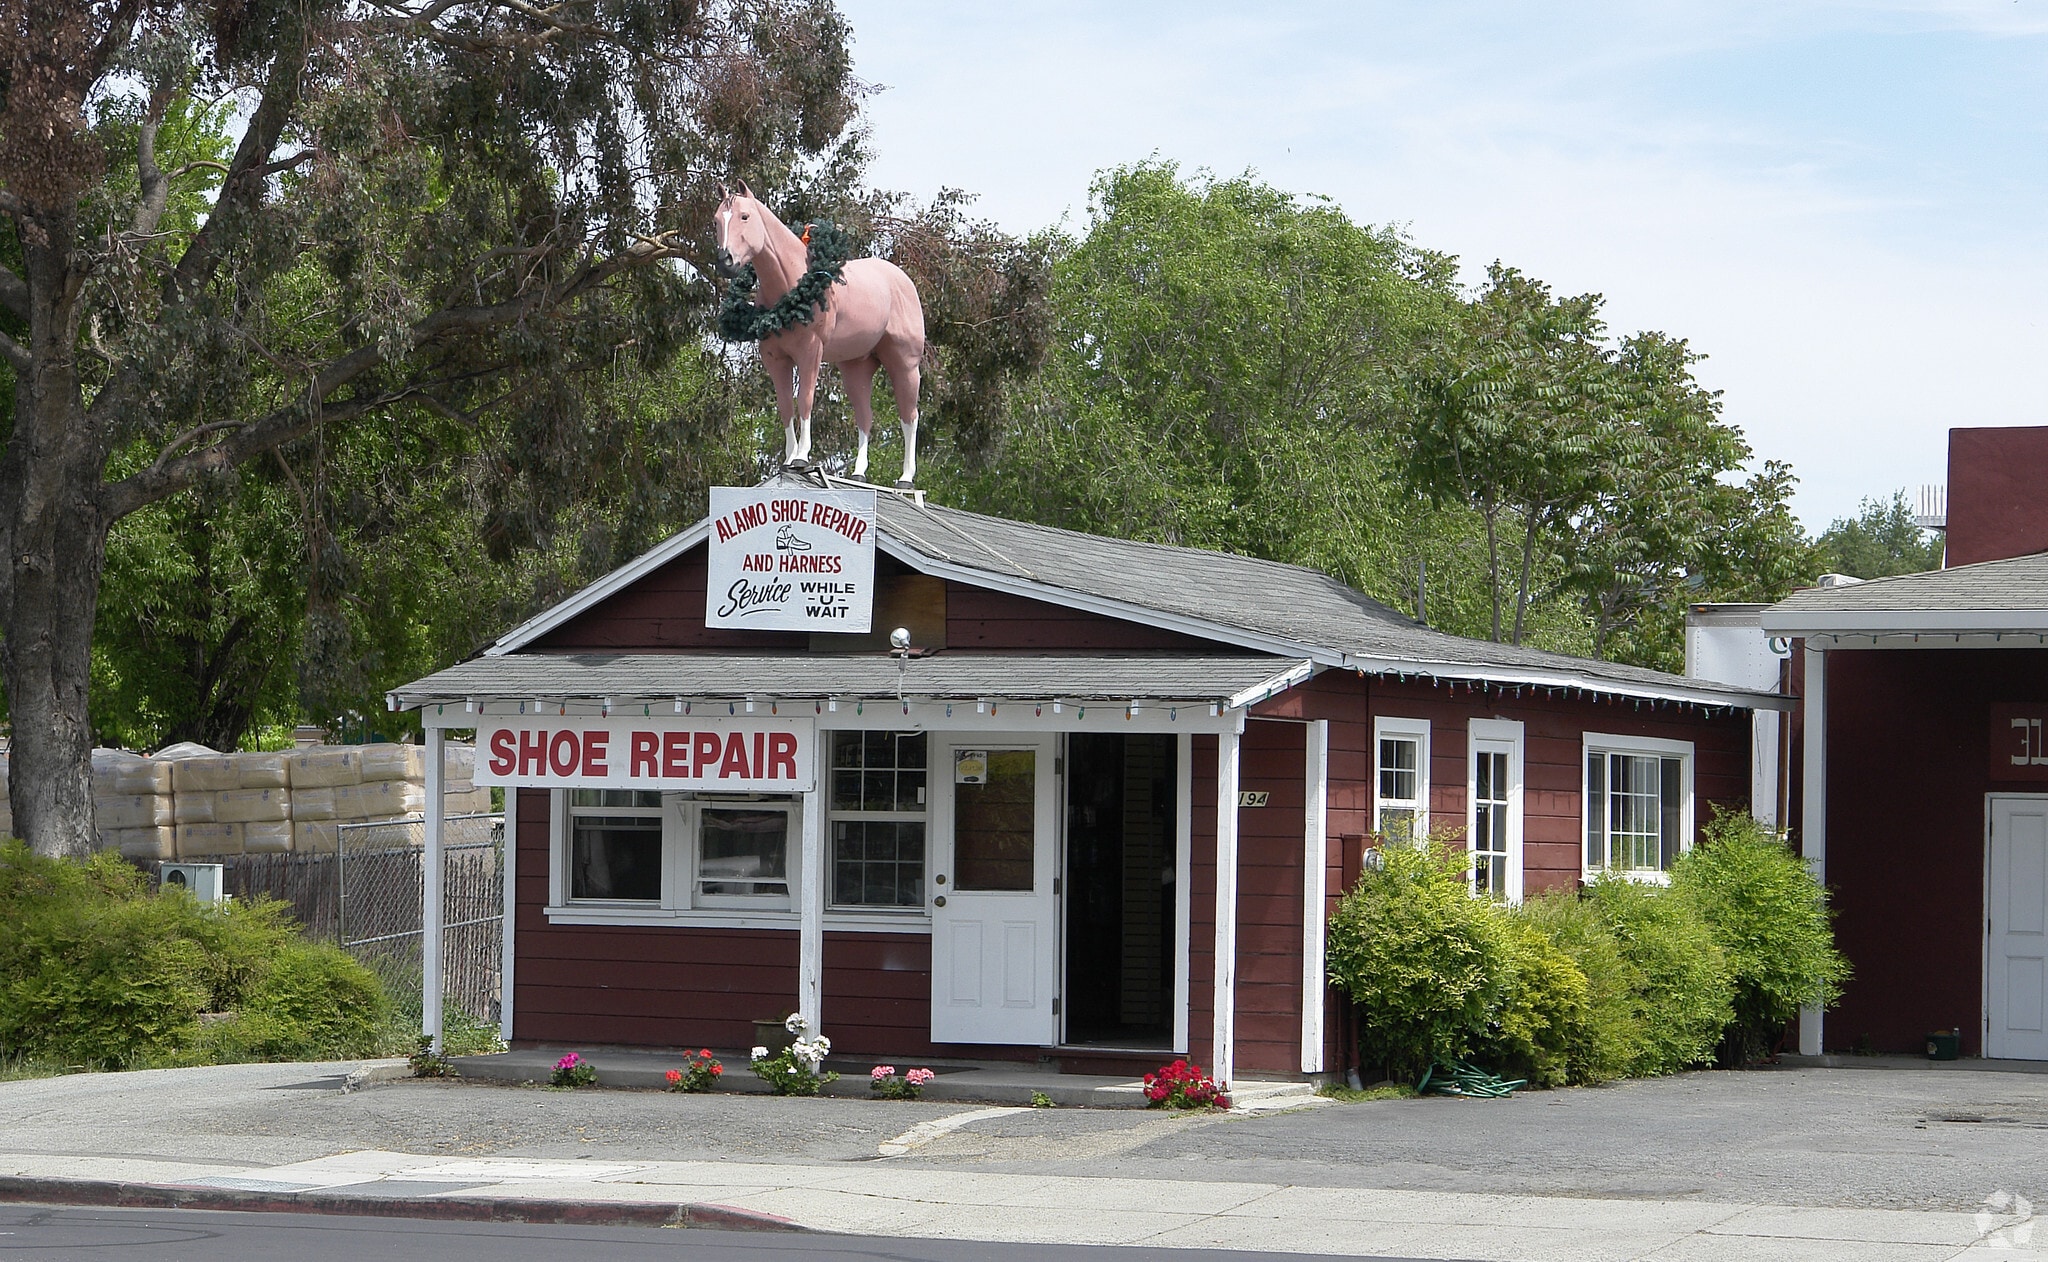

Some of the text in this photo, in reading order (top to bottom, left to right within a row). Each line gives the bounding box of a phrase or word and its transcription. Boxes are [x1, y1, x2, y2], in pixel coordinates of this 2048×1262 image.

[715, 499, 867, 544] ALAMO SHOE REPAIR
[742, 554, 842, 574] AND HARNESS
[717, 576, 792, 618] Service
[800, 582, 855, 594] WHILE
[806, 606, 849, 618] WAIT
[488, 729, 798, 780] SHOE REPAIR
